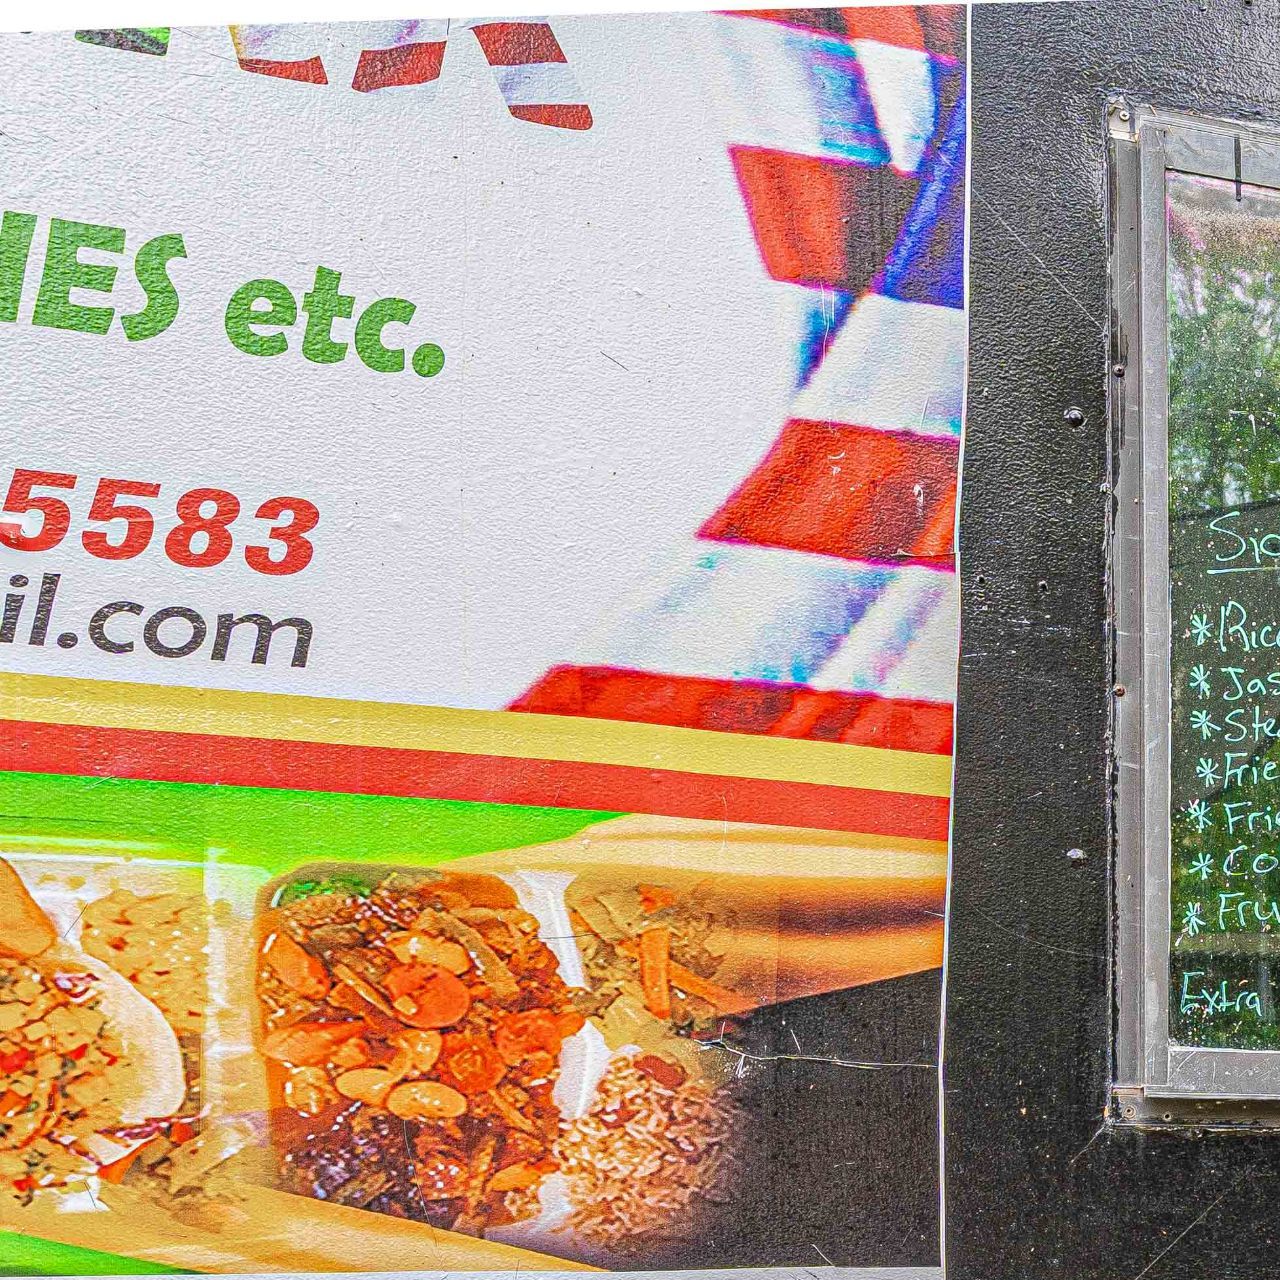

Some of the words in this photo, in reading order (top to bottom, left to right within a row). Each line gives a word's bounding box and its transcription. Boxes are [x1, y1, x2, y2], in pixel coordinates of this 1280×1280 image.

[223, 264, 448, 379] etc.
[0, 467, 320, 577] 5583
[1180, 971, 1263, 1017] Extra
